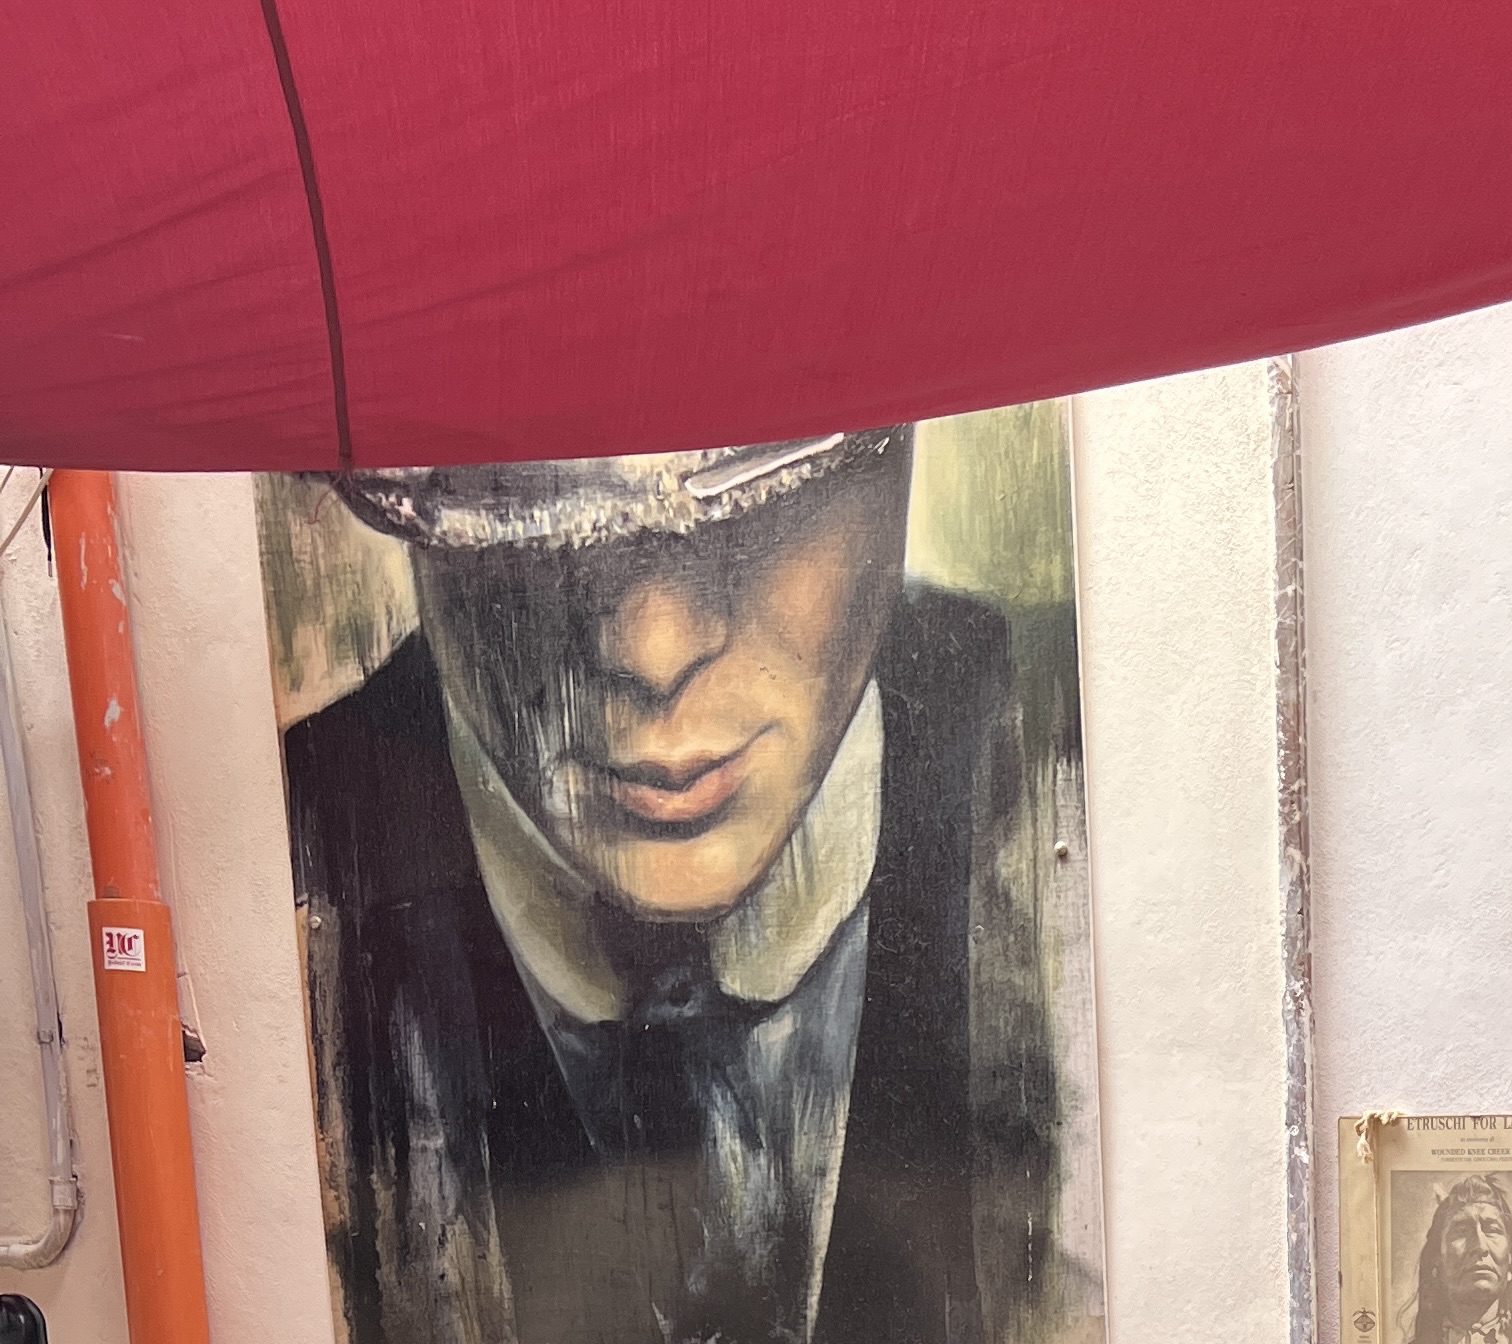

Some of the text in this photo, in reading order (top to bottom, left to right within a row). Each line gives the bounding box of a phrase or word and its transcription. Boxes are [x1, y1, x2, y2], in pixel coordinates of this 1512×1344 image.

[1407, 1117, 1466, 1131] ETRUSCHI
[1472, 1117, 1497, 1130] FOR
[1467, 1148, 1486, 1156] KNEE
[1487, 1148, 1511, 1156] CREEK
